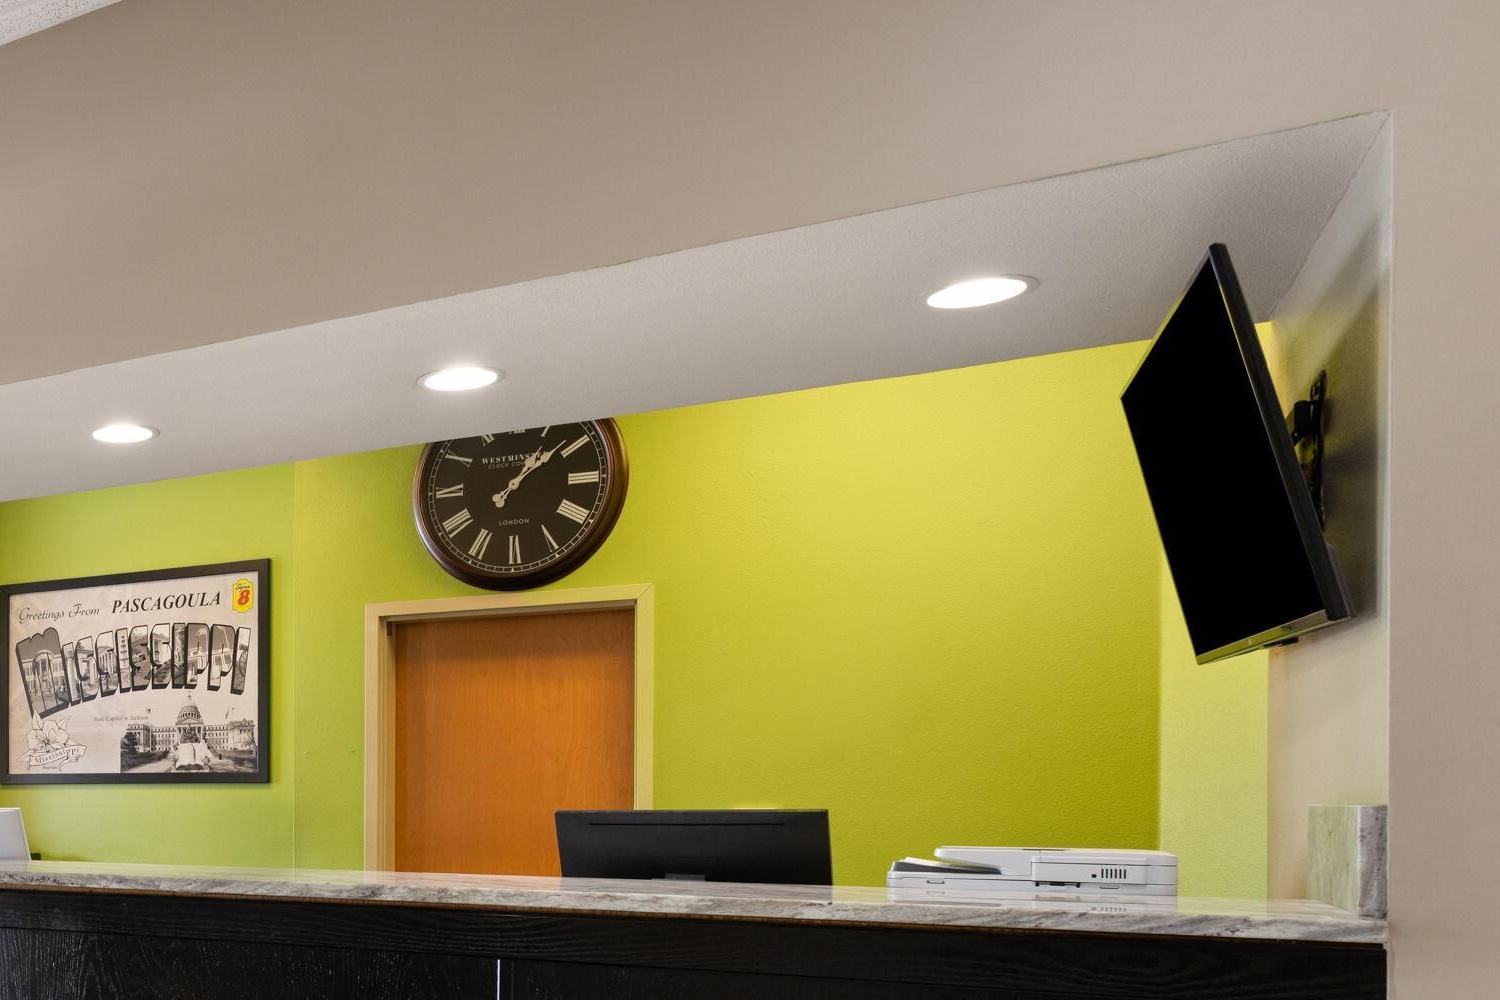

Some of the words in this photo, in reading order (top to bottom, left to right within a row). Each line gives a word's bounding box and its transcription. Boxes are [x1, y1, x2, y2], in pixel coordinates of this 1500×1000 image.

[481, 450, 548, 465] WESTMINS
[488, 462, 509, 470] CLOCK
[498, 518, 530, 527] LONDON
[237, 590, 251, 605] 8
[19, 607, 65, 624] Greetings
[69, 603, 100, 618] From
[112, 591, 220, 614] PASCAGOULA
[35, 748, 80, 763] Mississippi
